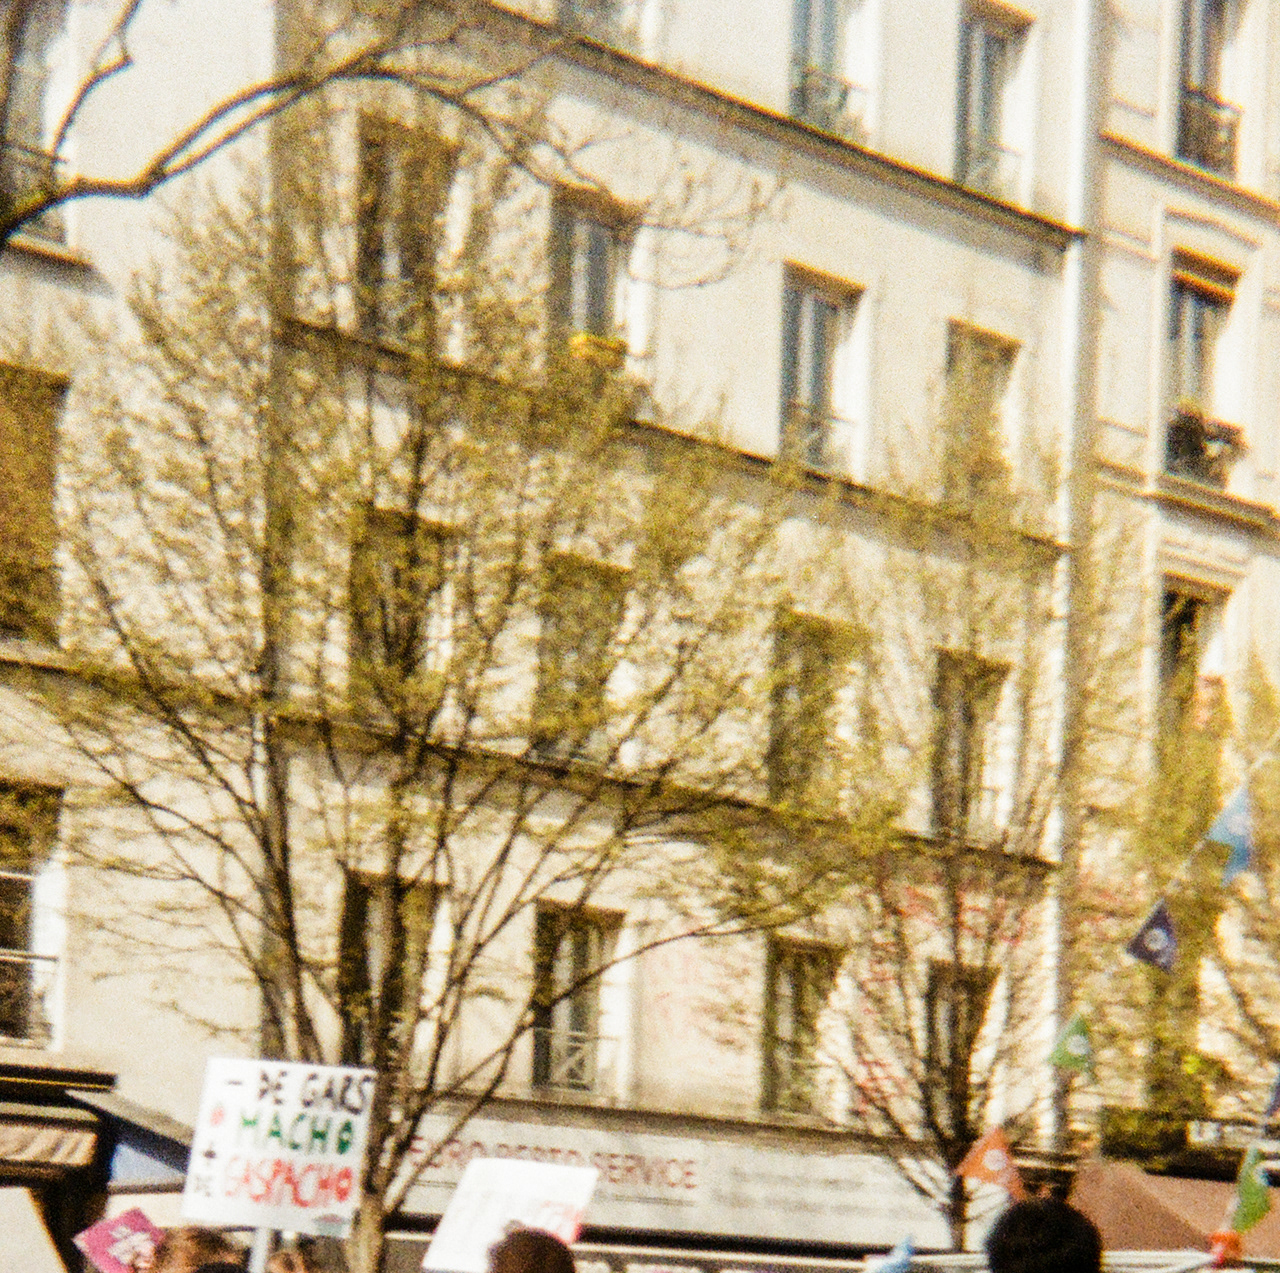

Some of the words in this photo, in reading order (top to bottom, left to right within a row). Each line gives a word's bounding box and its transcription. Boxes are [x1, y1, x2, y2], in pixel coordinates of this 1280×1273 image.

[258, 1068, 289, 1106] DE
[300, 1070, 376, 1116] GARS
[238, 1108, 354, 1156] MACHO
[592, 1151, 698, 1190] SERVICE
